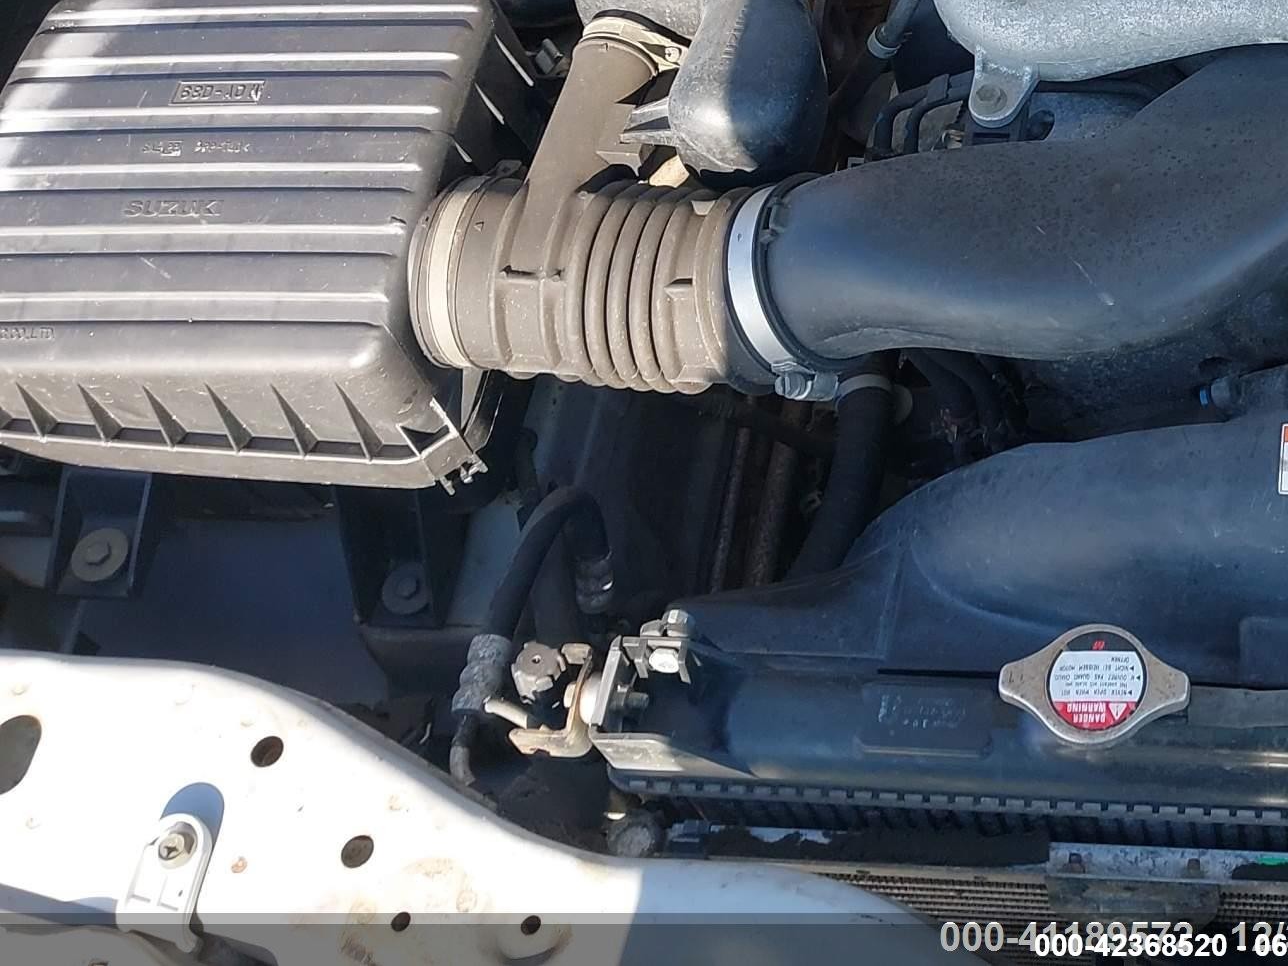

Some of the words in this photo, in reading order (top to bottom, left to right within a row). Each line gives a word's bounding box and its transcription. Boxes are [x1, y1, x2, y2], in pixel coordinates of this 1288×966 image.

[123, 198, 225, 217] SUZUKI
[1066, 702, 1106, 713] WARNING
[1073, 713, 1106, 723] DANGER
